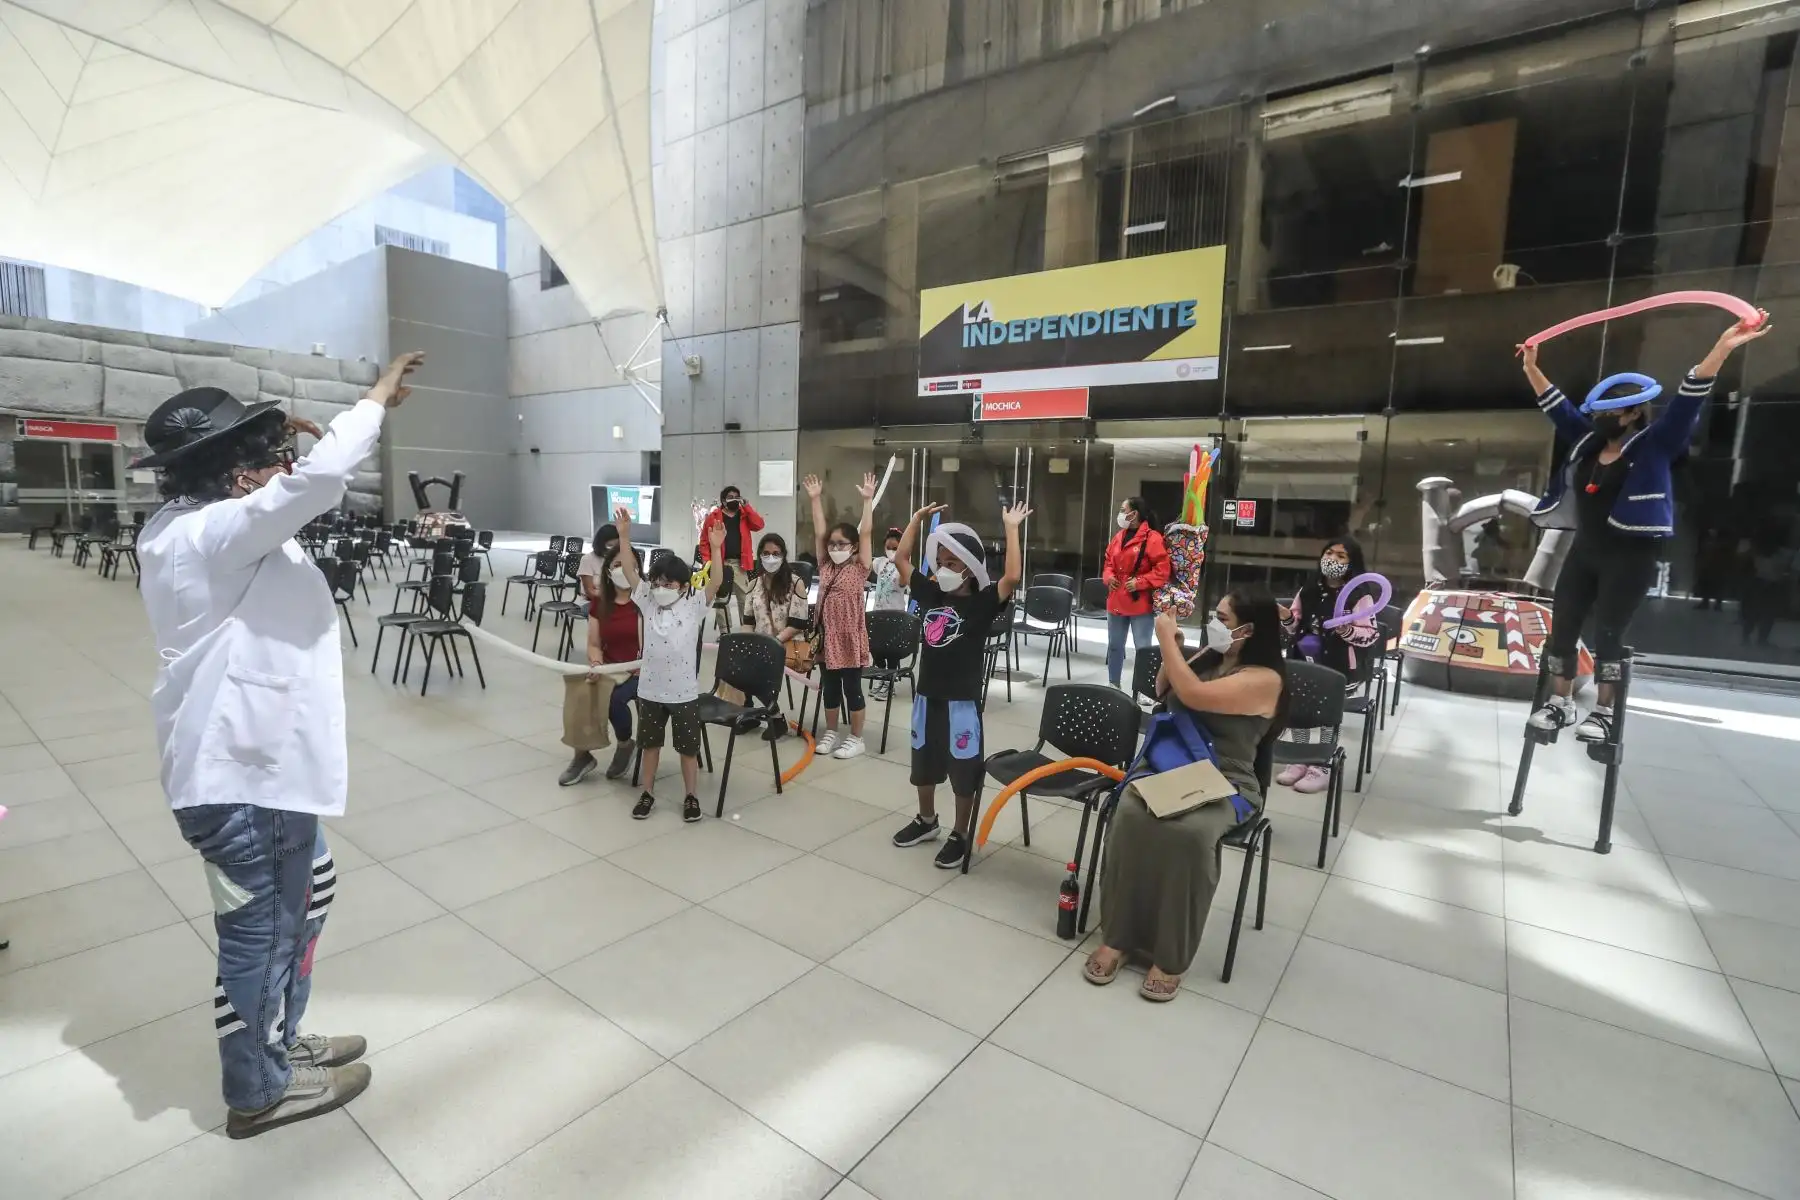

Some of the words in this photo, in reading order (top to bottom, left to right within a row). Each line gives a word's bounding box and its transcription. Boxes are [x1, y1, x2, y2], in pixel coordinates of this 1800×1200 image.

[962, 299, 1197, 348] INDEPENDIENTE
[963, 300, 994, 325] LA
[985, 401, 1021, 411] MOCHICA
